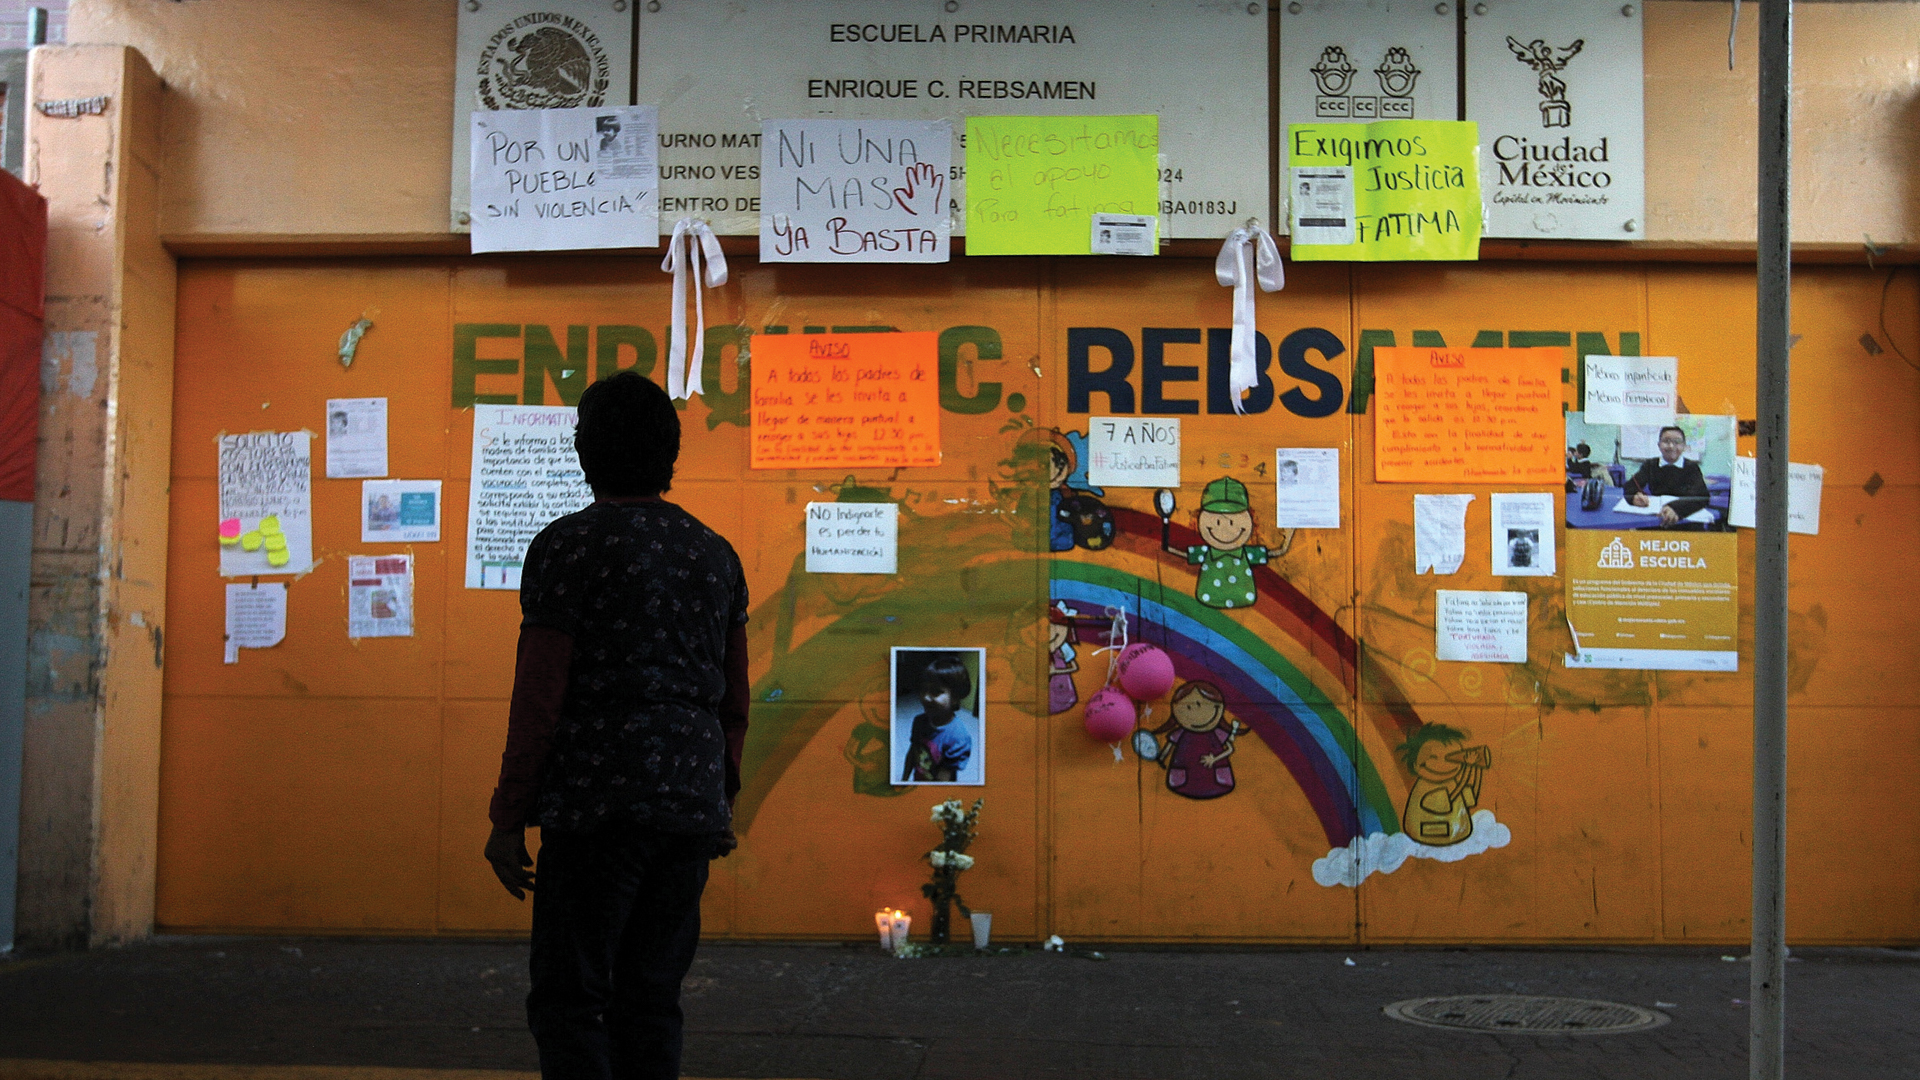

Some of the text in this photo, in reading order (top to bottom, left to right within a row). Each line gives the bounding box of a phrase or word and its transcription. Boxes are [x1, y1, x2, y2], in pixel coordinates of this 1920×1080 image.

[477, 12, 610, 78] ESTADOS UNIDOS MEXICANOS
[830, 24, 1076, 43] ESCUELA PRIMARIA
[808, 79, 1096, 99] ENRIQUE C. REBSAMEN
[486, 131, 546, 166] POR
[657, 133, 717, 149] URNO
[838, 127, 917, 167] UNA
[1294, 129, 1427, 167] Exigimos
[1492, 134, 1610, 163] Ciudad
[658, 165, 716, 180] URNO
[1033, 163, 1112, 190] apoyo
[1364, 163, 1466, 193] Justicia
[1497, 162, 1612, 189] México
[657, 197, 729, 212] ENTRO
[796, 175, 894, 212] MAS
[487, 198, 520, 218] SIN
[772, 214, 938, 256] YA BASTA
[1354, 209, 1461, 244] FATIMA
[768, 369, 778, 383] A
[831, 365, 850, 382] los
[855, 365, 900, 387] padres
[909, 363, 926, 382] de
[826, 387, 842, 403] les
[495, 409, 579, 426] INFORMATIV
[480, 427, 499, 447] Se
[1102, 422, 1176, 445] 7 AÑOS
[810, 505, 831, 520] NO
[1640, 540, 1690, 552] MEJOR
[1640, 556, 1707, 569] ESCUELA
